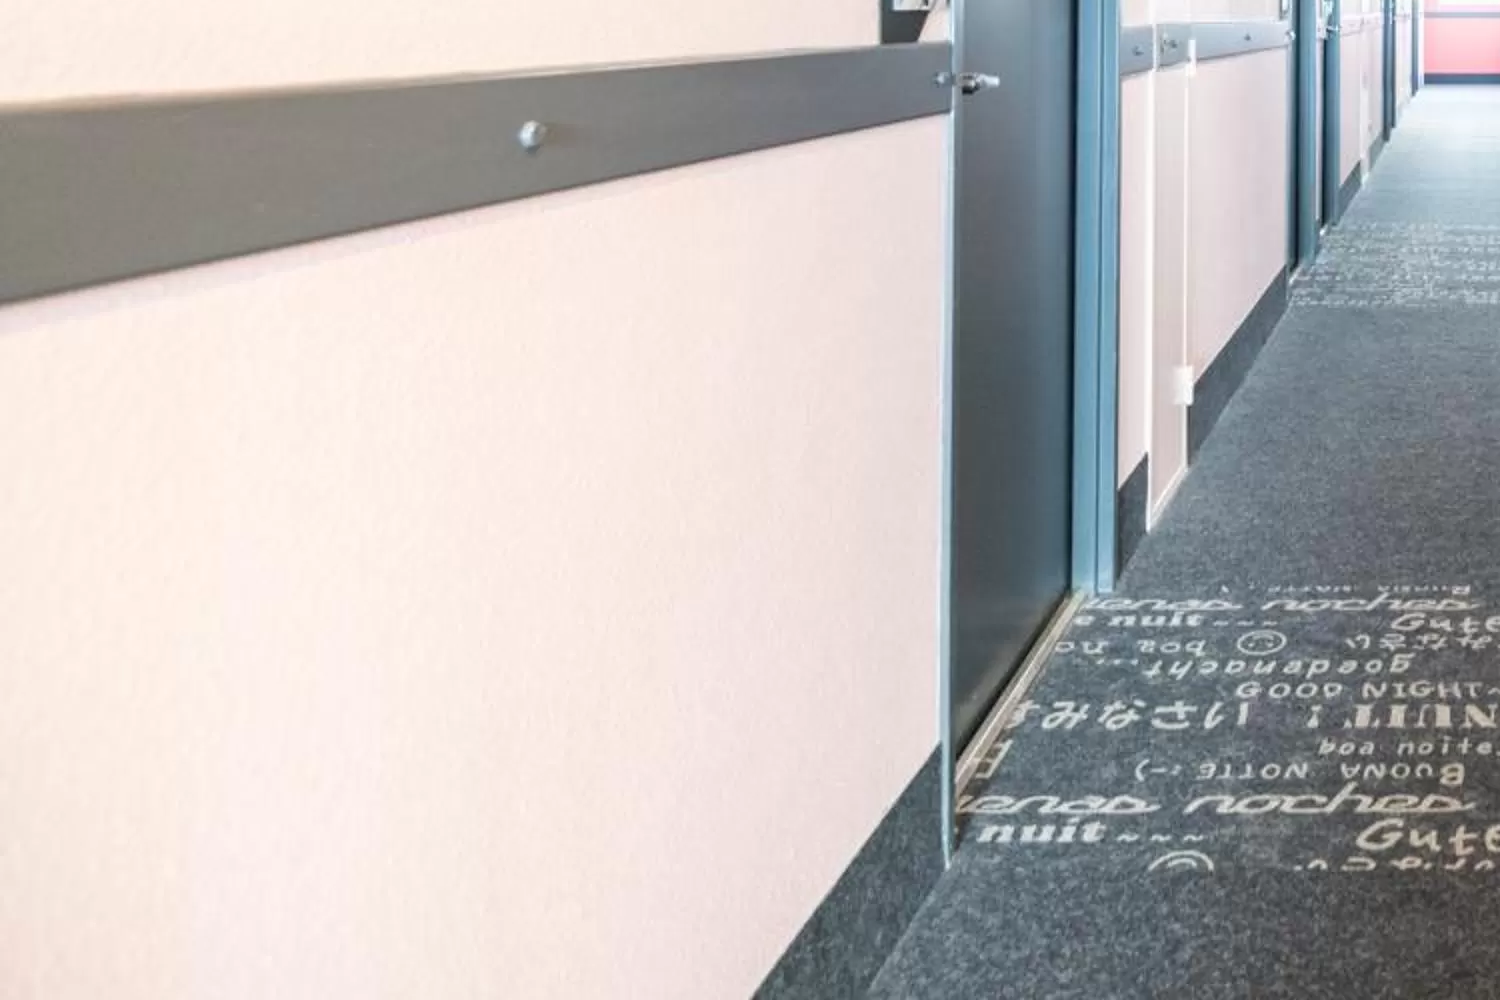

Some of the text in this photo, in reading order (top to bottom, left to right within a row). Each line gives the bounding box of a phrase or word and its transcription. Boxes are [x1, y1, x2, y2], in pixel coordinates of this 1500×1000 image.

[1261, 592, 1480, 611] noches
[1107, 610, 1203, 627] nuit
[1236, 681, 1342, 699] GOOD
[1342, 703, 1498, 729] NUIT
[1318, 737, 1375, 756] boa
[1182, 781, 1477, 815] noches
[976, 816, 1107, 843] nuit
